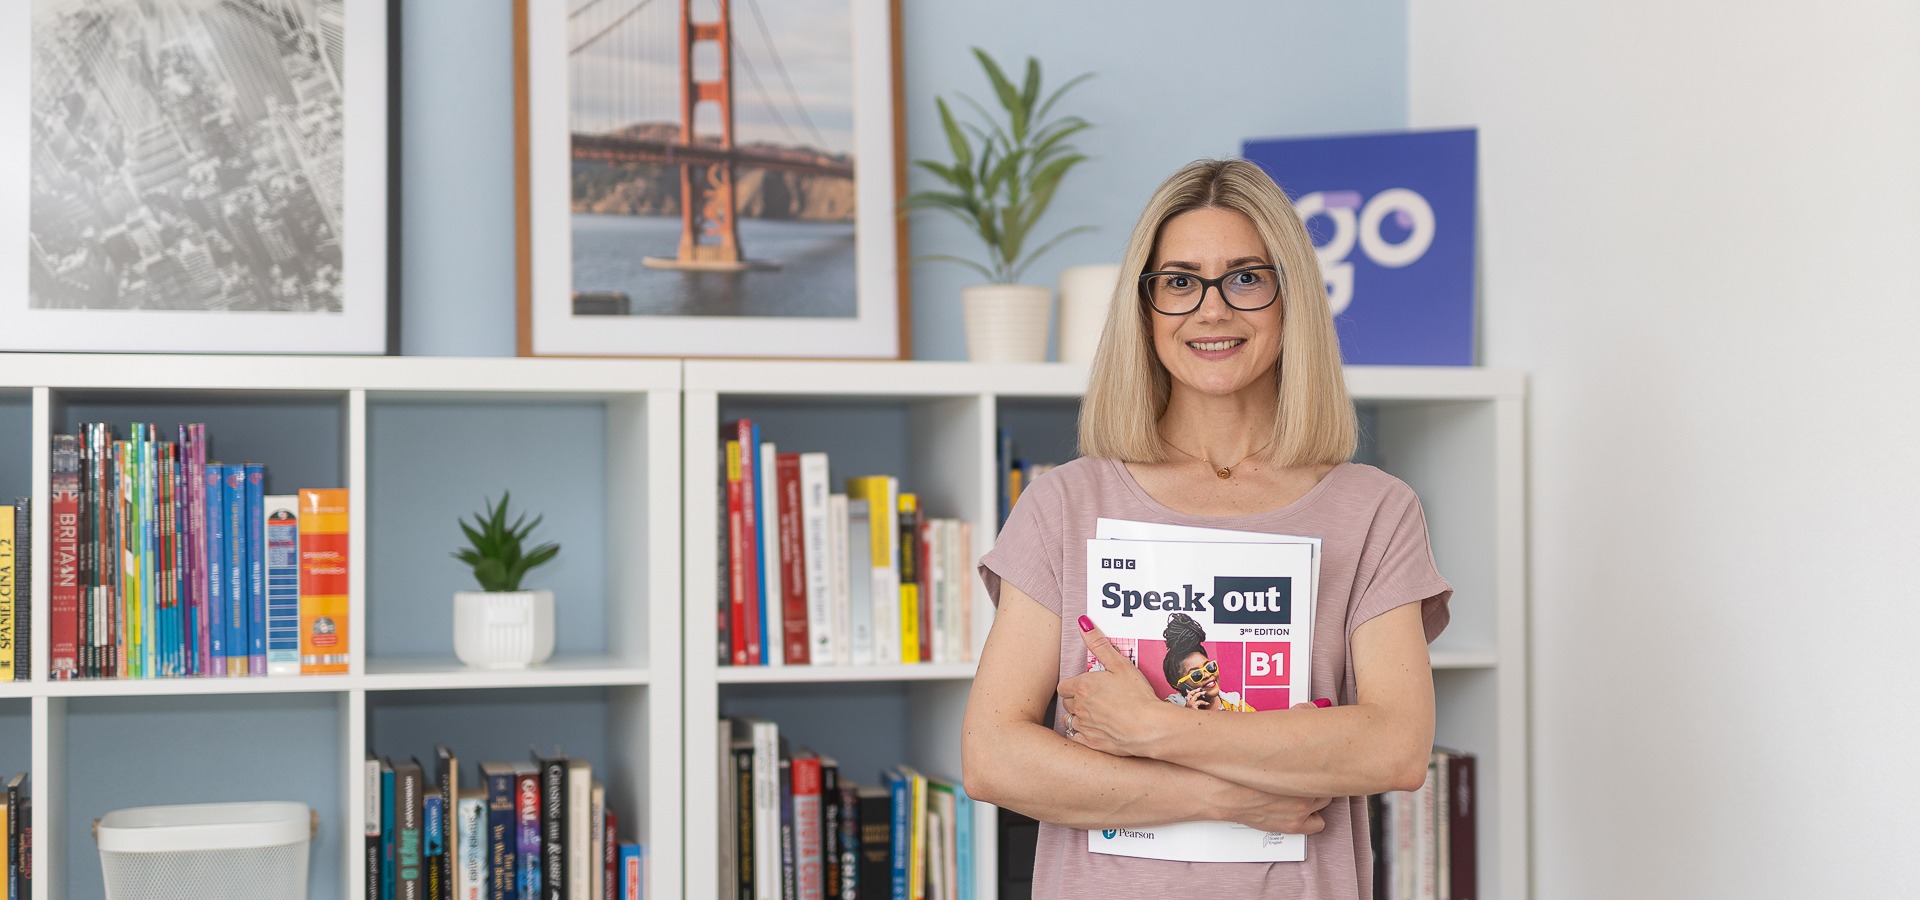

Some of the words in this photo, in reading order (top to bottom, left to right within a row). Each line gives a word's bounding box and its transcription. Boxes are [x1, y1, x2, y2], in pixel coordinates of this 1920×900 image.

[1102, 558, 1136, 570] BBC
[1101, 583, 1208, 619] Speak
[1223, 586, 1281, 612] out
[1254, 628, 1290, 637] EDITION
[1250, 652, 1284, 677] B1
[548, 764, 562, 819] CHASING
[801, 800, 821, 858] TOYOTA
[1118, 827, 1155, 840] Pearson
[548, 843, 562, 888] RABBIT
